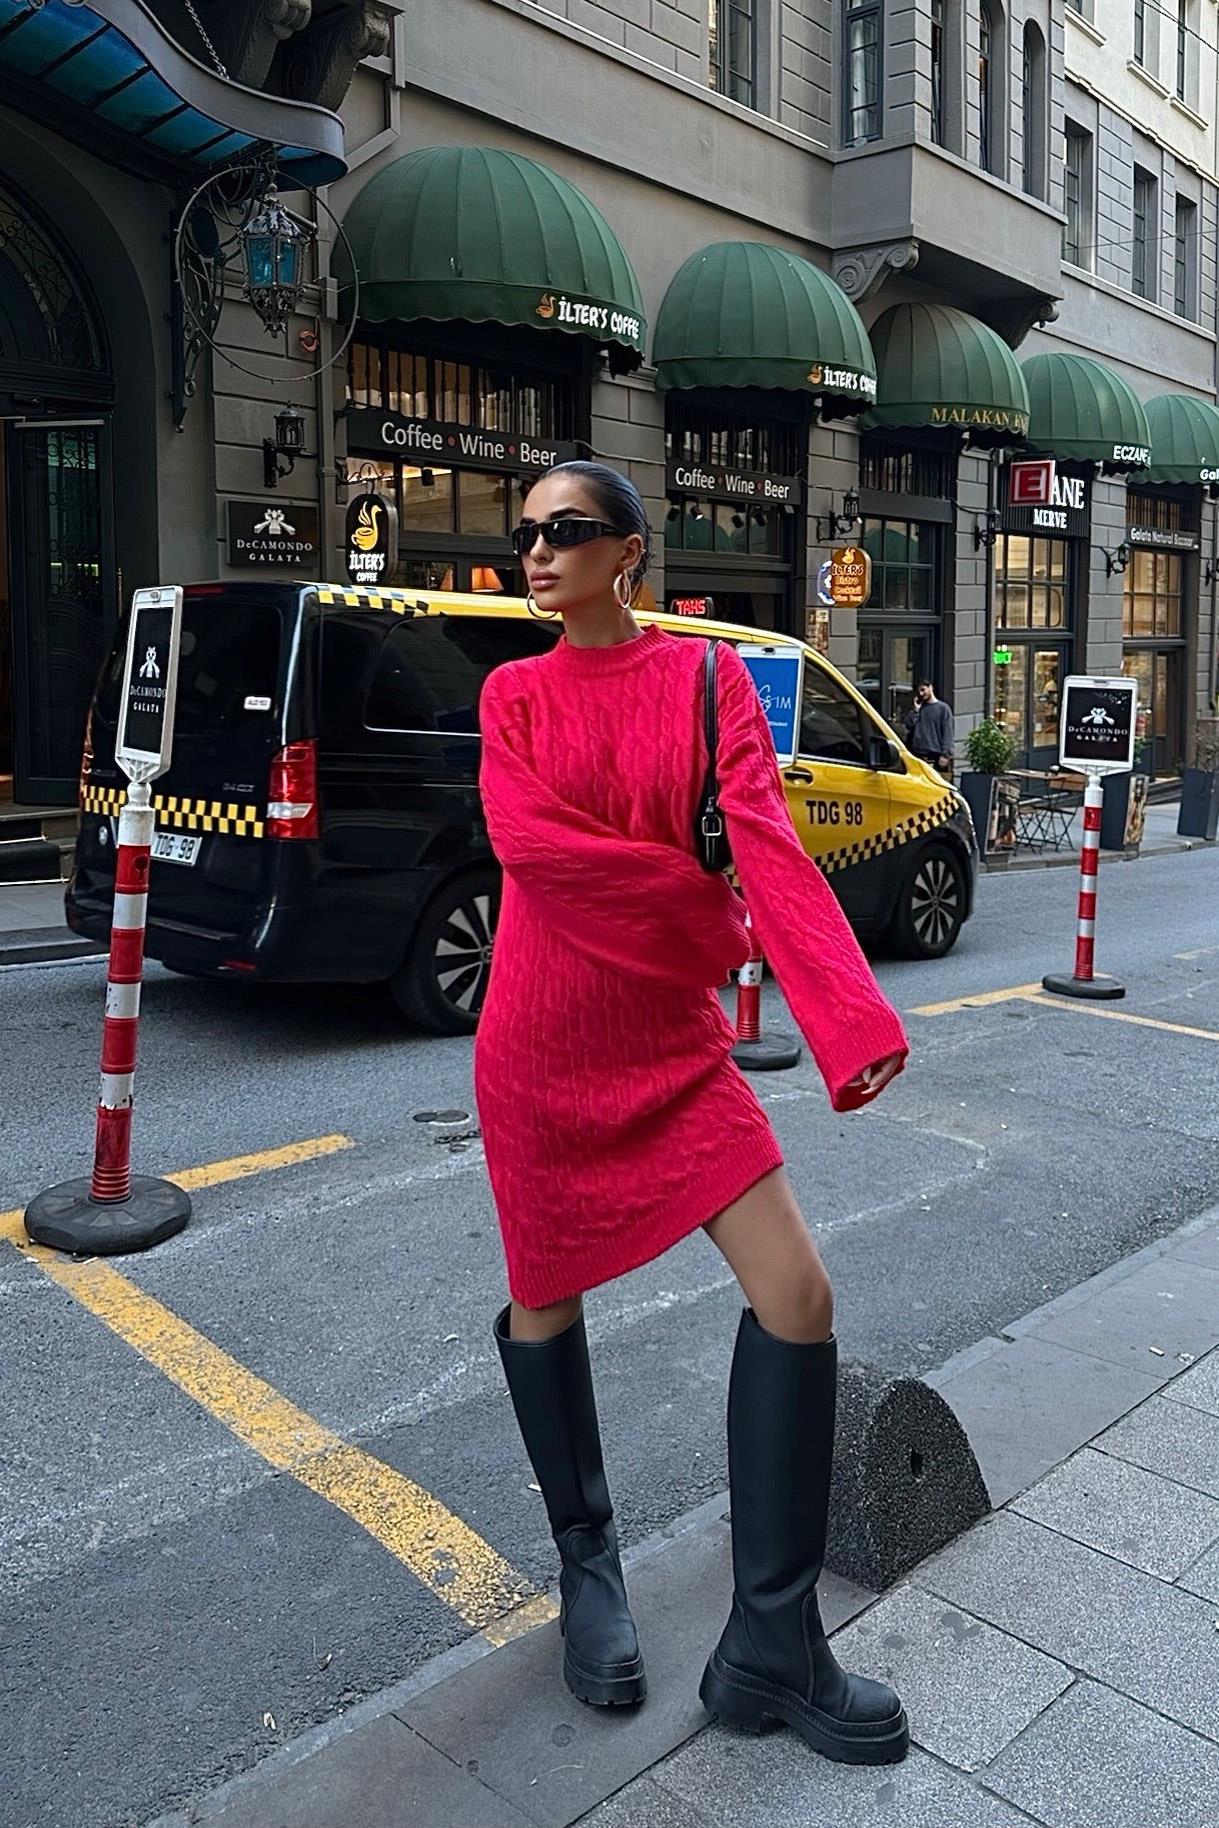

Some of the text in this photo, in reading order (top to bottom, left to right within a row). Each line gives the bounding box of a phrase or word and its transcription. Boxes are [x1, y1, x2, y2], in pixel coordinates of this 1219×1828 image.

[557, 296, 609, 329] İLTER'S
[823, 365, 859, 391] İLTER'S
[930, 407, 1010, 427] MALAKAN
[381, 421, 558, 467] Coffee Wine Beer
[675, 467, 790, 499] Coffee Wine Beer
[1033, 507, 1068, 529] MERVE
[236, 539, 313, 552] DeCAMONDO
[248, 552, 302, 563] GALATA
[348, 550, 386, 571] İLTER'S
[1068, 725, 1128, 735] DeCAMONDO
[806, 800, 863, 826] TDG 98
[154, 834, 195, 860] TDG 98
